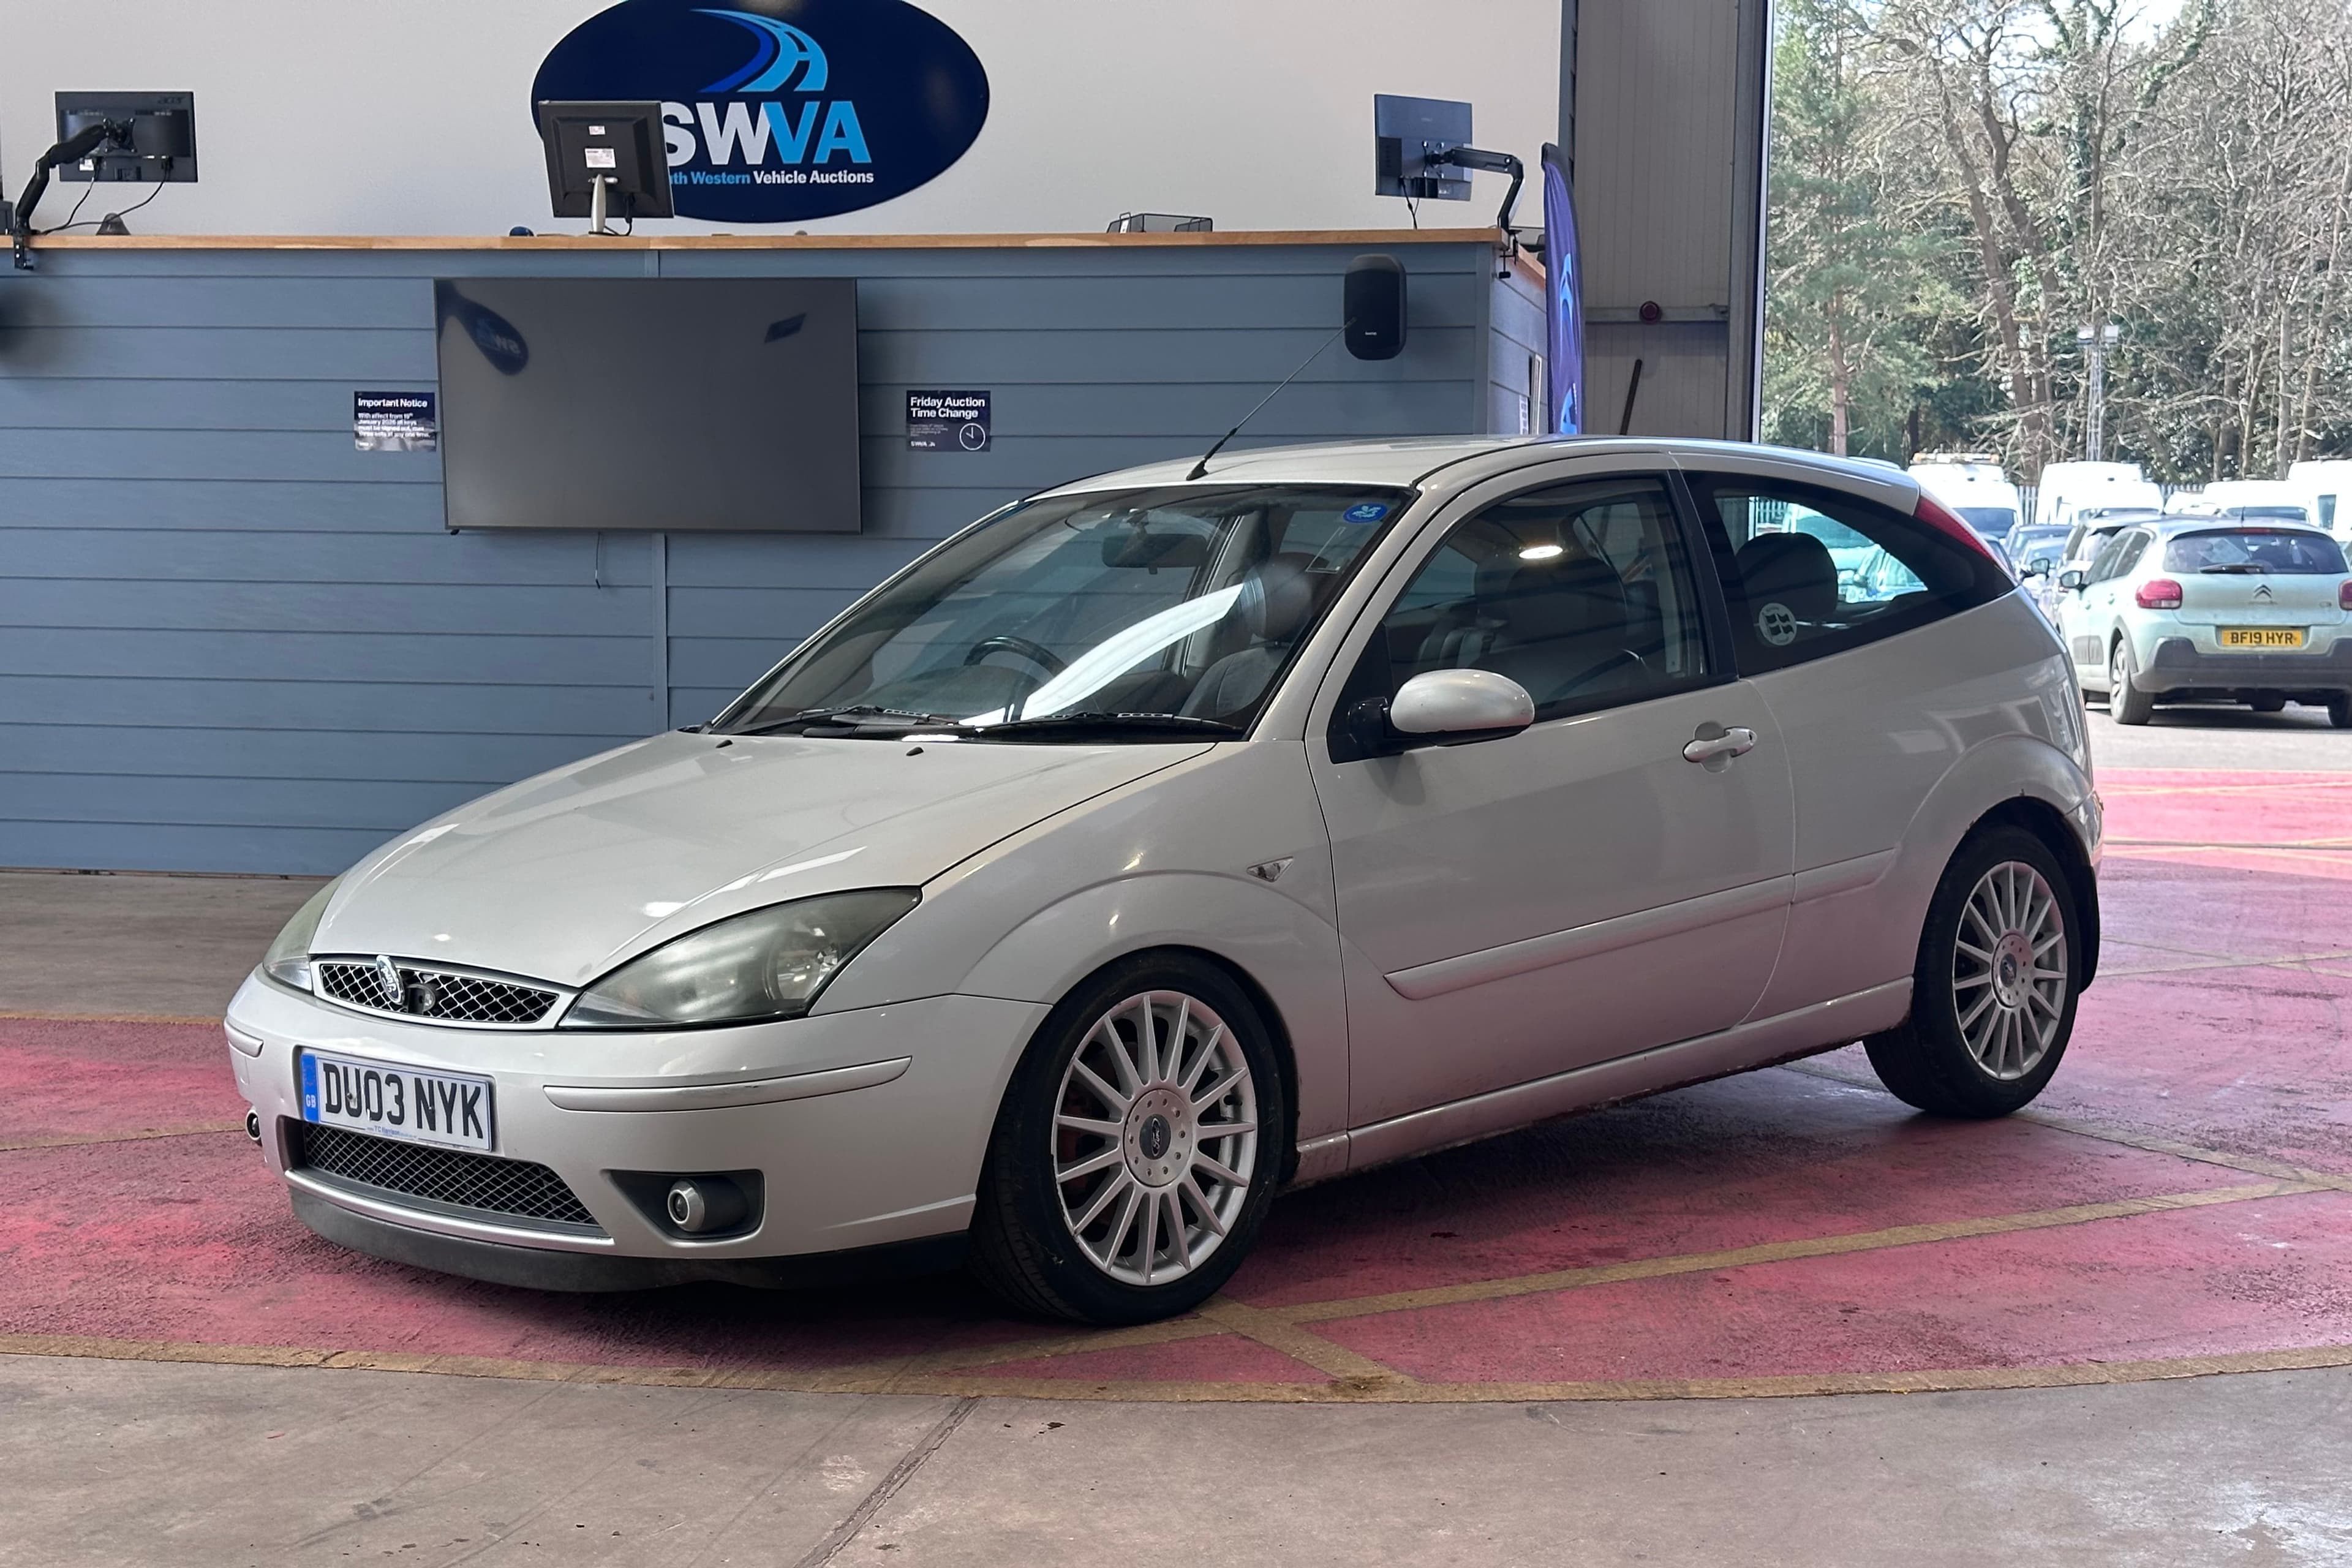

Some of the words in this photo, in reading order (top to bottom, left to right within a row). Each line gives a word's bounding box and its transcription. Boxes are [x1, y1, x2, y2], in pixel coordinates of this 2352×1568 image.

[691, 172, 750, 184] Western
[753, 170, 806, 184] Vehicle
[809, 170, 874, 184] Auctions
[358, 398, 399, 408] Important
[401, 399, 428, 407] Notice
[911, 397, 943, 408] Friday
[944, 397, 985, 407] Auction
[911, 408, 937, 418] Time
[938, 409, 978, 420] Change
[2231, 632, 2261, 644] BF19
[2266, 633, 2293, 644] HYR
[306, 1095, 316, 1107] GB
[323, 1063, 405, 1125] DU03
[414, 1077, 484, 1139] NYK
